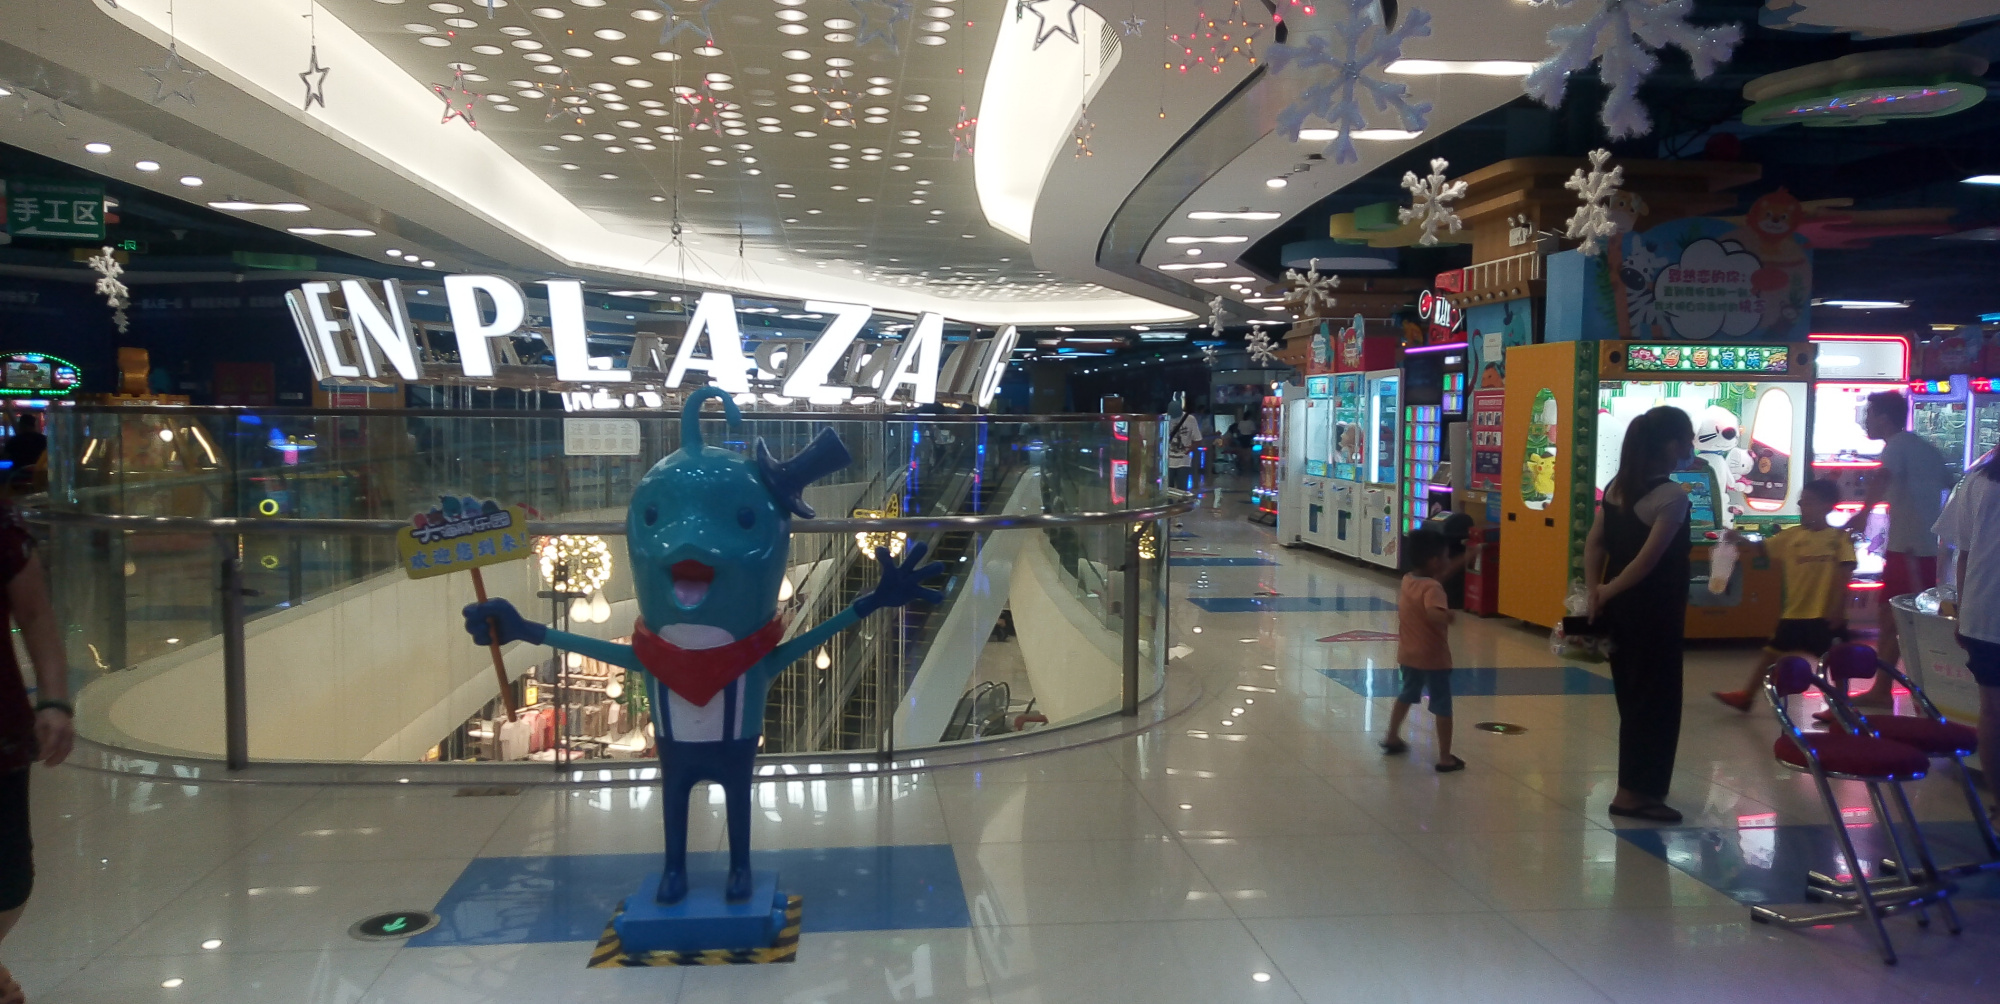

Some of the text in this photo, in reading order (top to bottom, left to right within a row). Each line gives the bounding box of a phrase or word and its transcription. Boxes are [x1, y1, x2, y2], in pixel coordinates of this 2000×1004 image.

[12, 197, 99, 225] 手工区
[443, 274, 948, 404] PLAZA
[410, 532, 528, 569] 欢迎您到来!
